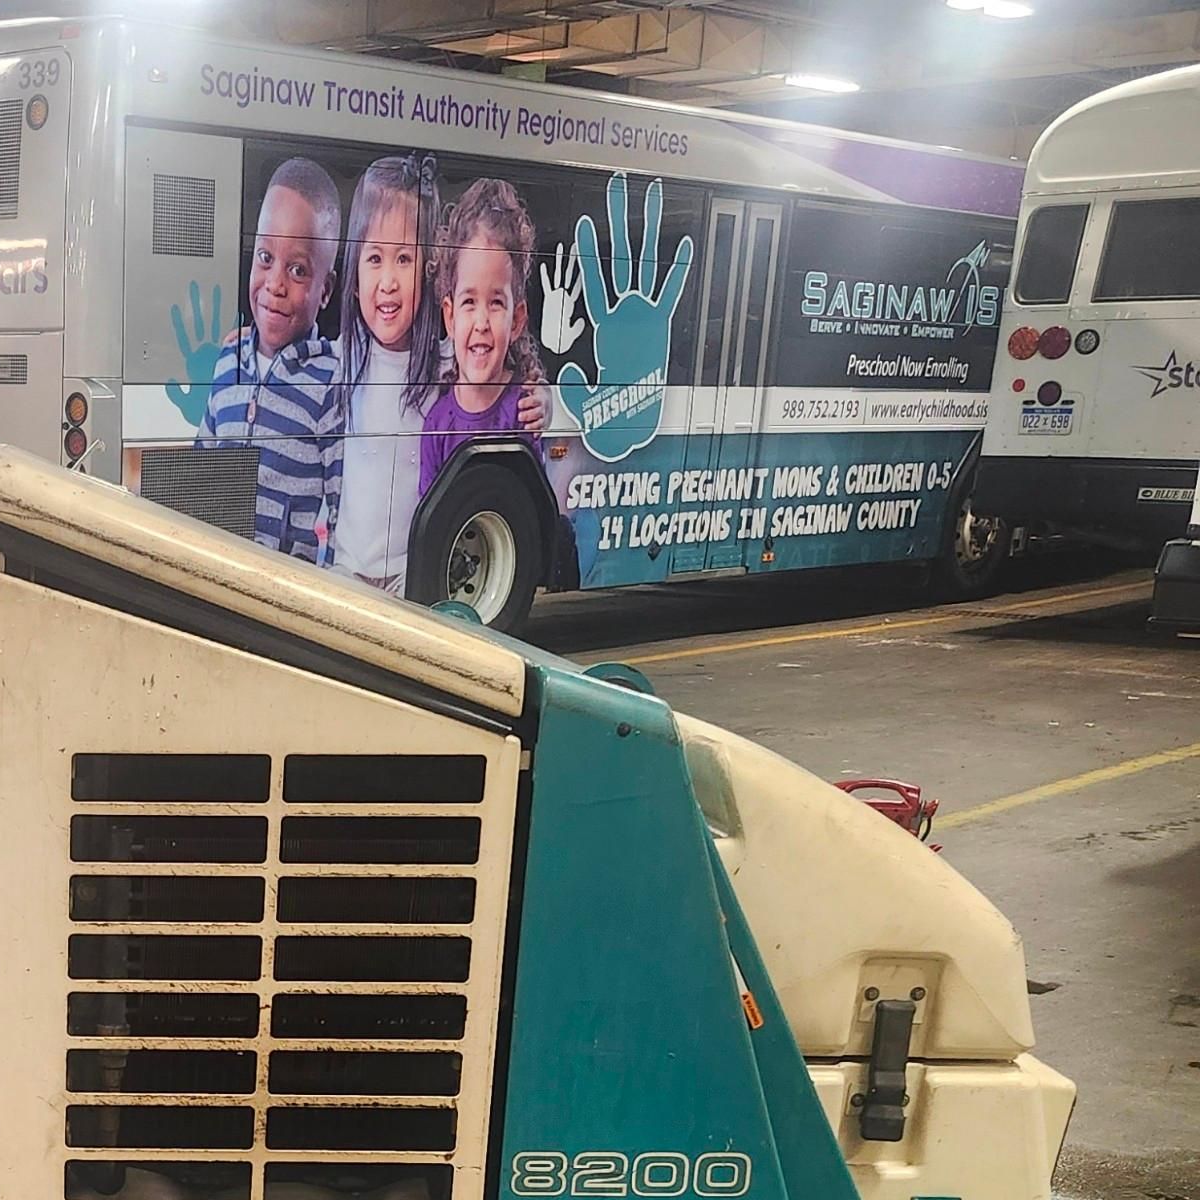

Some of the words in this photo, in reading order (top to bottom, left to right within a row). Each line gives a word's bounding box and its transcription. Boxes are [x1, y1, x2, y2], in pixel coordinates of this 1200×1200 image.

[18, 58, 60, 90] 339
[200, 63, 315, 109] Saginaw
[323, 81, 405, 119] Transit
[411, 93, 512, 140] Authority
[516, 107, 606, 145] Regional
[610, 121, 689, 156] Services
[801, 271, 956, 323] SAGINAW
[911, 325, 955, 339] EMPOWER
[847, 354, 900, 377] Preschool
[900, 356, 922, 377] Now
[924, 356, 969, 384] Enrolling
[582, 368, 664, 435] PRESCHOOL
[782, 399, 860, 419] 989.752.2193
[1022, 415, 1040, 428] 022
[1050, 414, 1070, 428] 698
[567, 472, 661, 509] SERVING
[667, 468, 770, 505] PREGNANT
[772, 465, 824, 499] MOMS
[825, 464, 840, 497] &
[845, 461, 924, 495] CHILDREN
[1153, 489, 1180, 499] BLUE
[599, 515, 624, 550] 14
[629, 508, 732, 548] LOCATIONS
[737, 507, 767, 539] IN
[770, 503, 853, 538] SAGINAW
[857, 498, 922, 531] COUNTY
[510, 1151, 752, 1197] 8200
